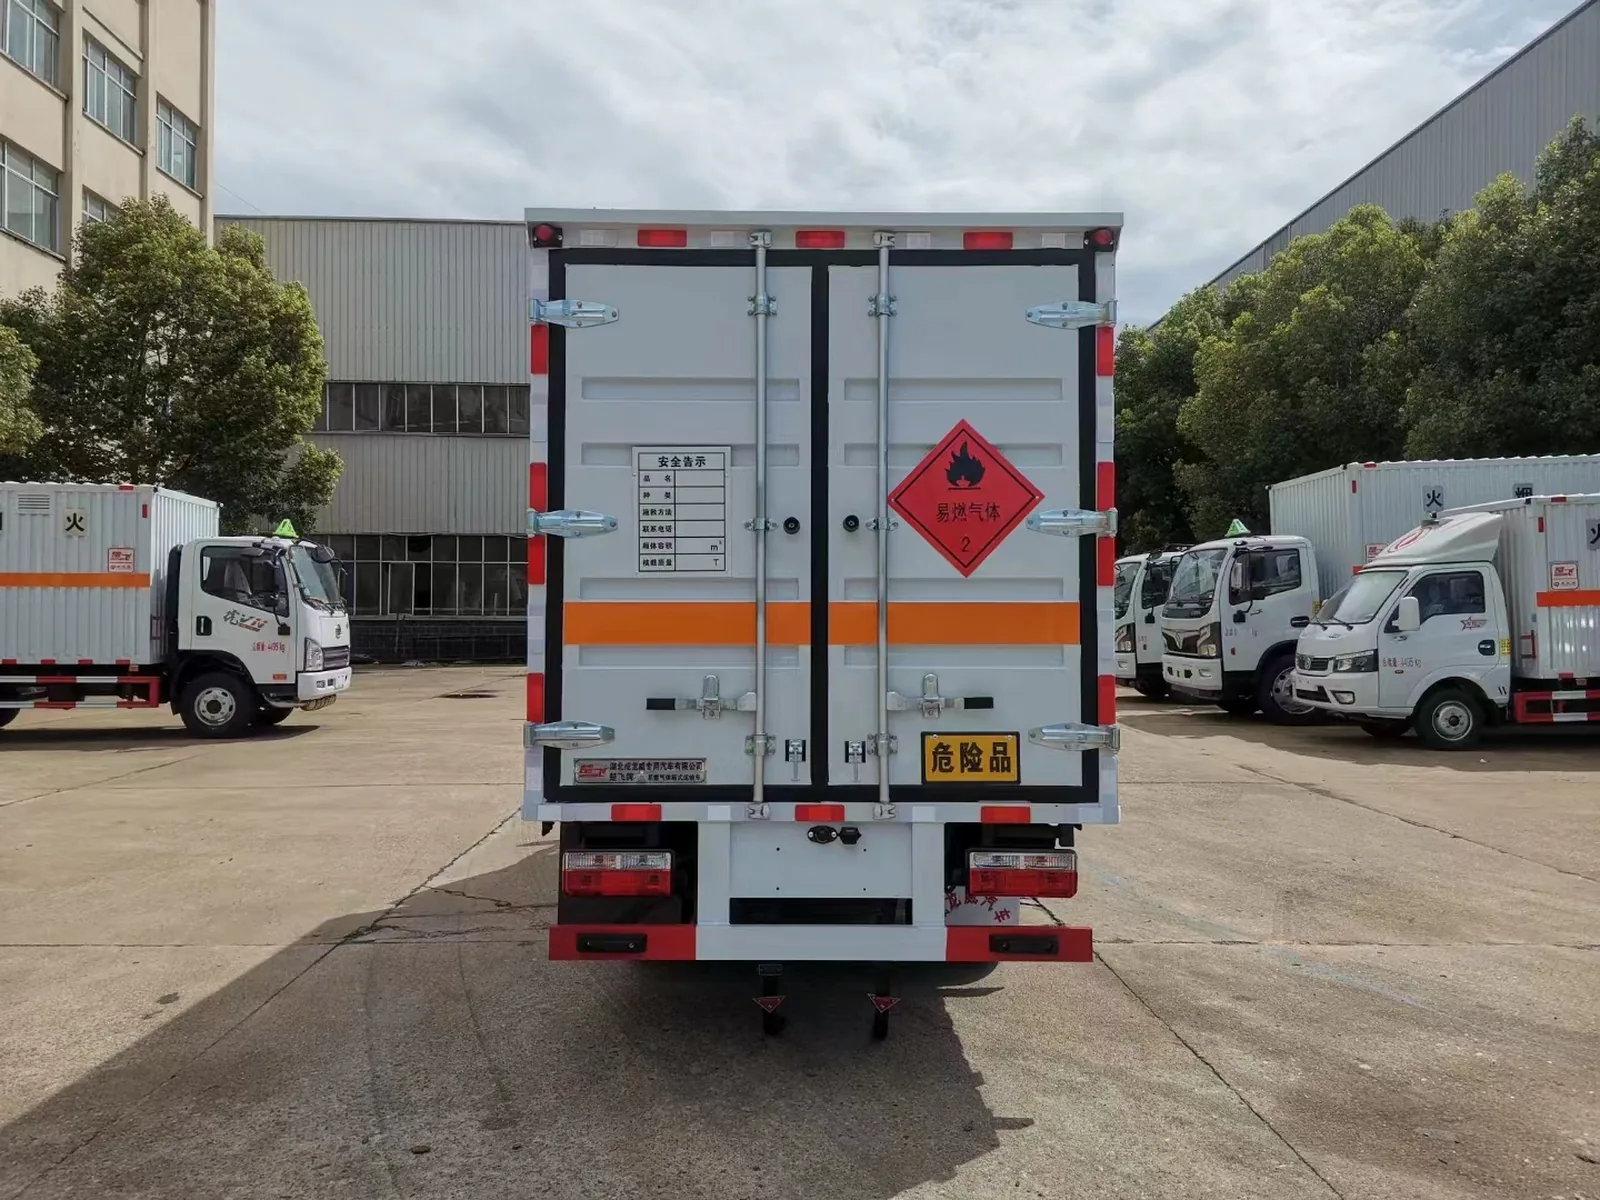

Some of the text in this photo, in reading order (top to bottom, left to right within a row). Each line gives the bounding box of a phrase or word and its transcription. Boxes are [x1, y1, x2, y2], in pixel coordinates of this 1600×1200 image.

[658, 456, 706, 468] 安全告示
[1426, 490, 1443, 508] 火
[936, 502, 1001, 523] 易燃气体
[65, 512, 85, 532] 火
[642, 525, 672, 533] 联系电话
[961, 536, 970, 553] 2
[713, 558, 719, 566] T
[931, 742, 1011, 773] 危险品
